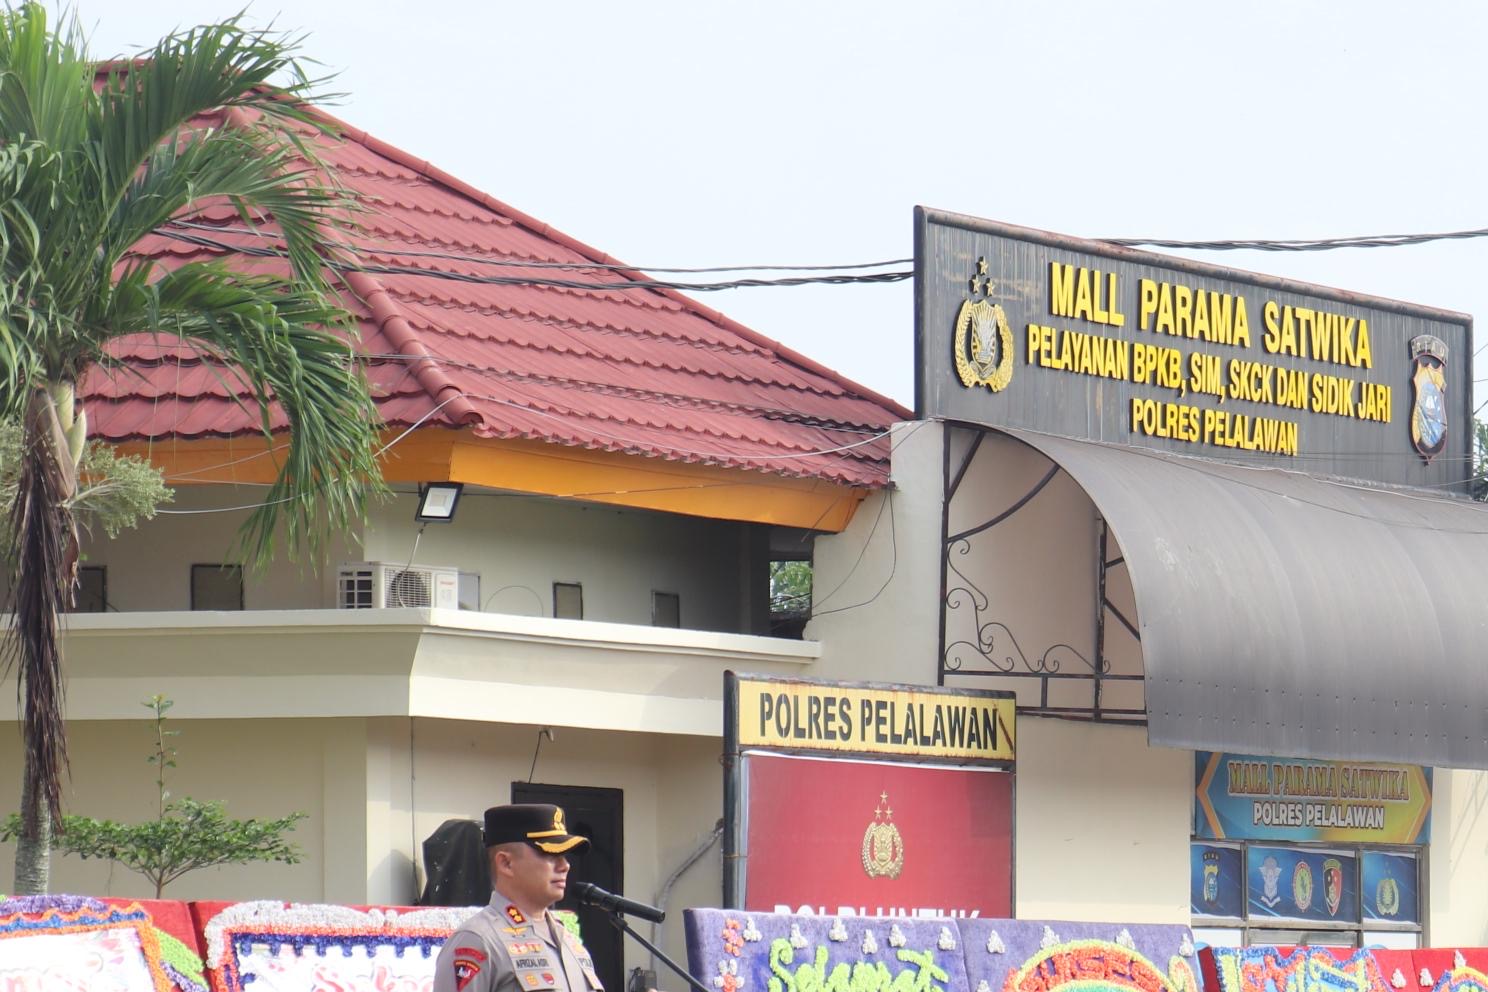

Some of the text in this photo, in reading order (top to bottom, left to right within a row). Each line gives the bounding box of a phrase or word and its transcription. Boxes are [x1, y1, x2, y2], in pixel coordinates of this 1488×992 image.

[1050, 261, 1373, 369] MALL PARAMA SATWIKA
[1026, 323, 1392, 424] PELAYANAN BPKB, SIM, SKCK DAN SIDIK JARI
[1130, 397, 1299, 457] POLRES PELALAWAN
[759, 692, 998, 751] POLRES PELALAWAN
[1273, 764, 1338, 798] PARAMA
[1340, 767, 1410, 801] SATWIKA
[1253, 802, 1385, 830] POLRES PELALAWAN
